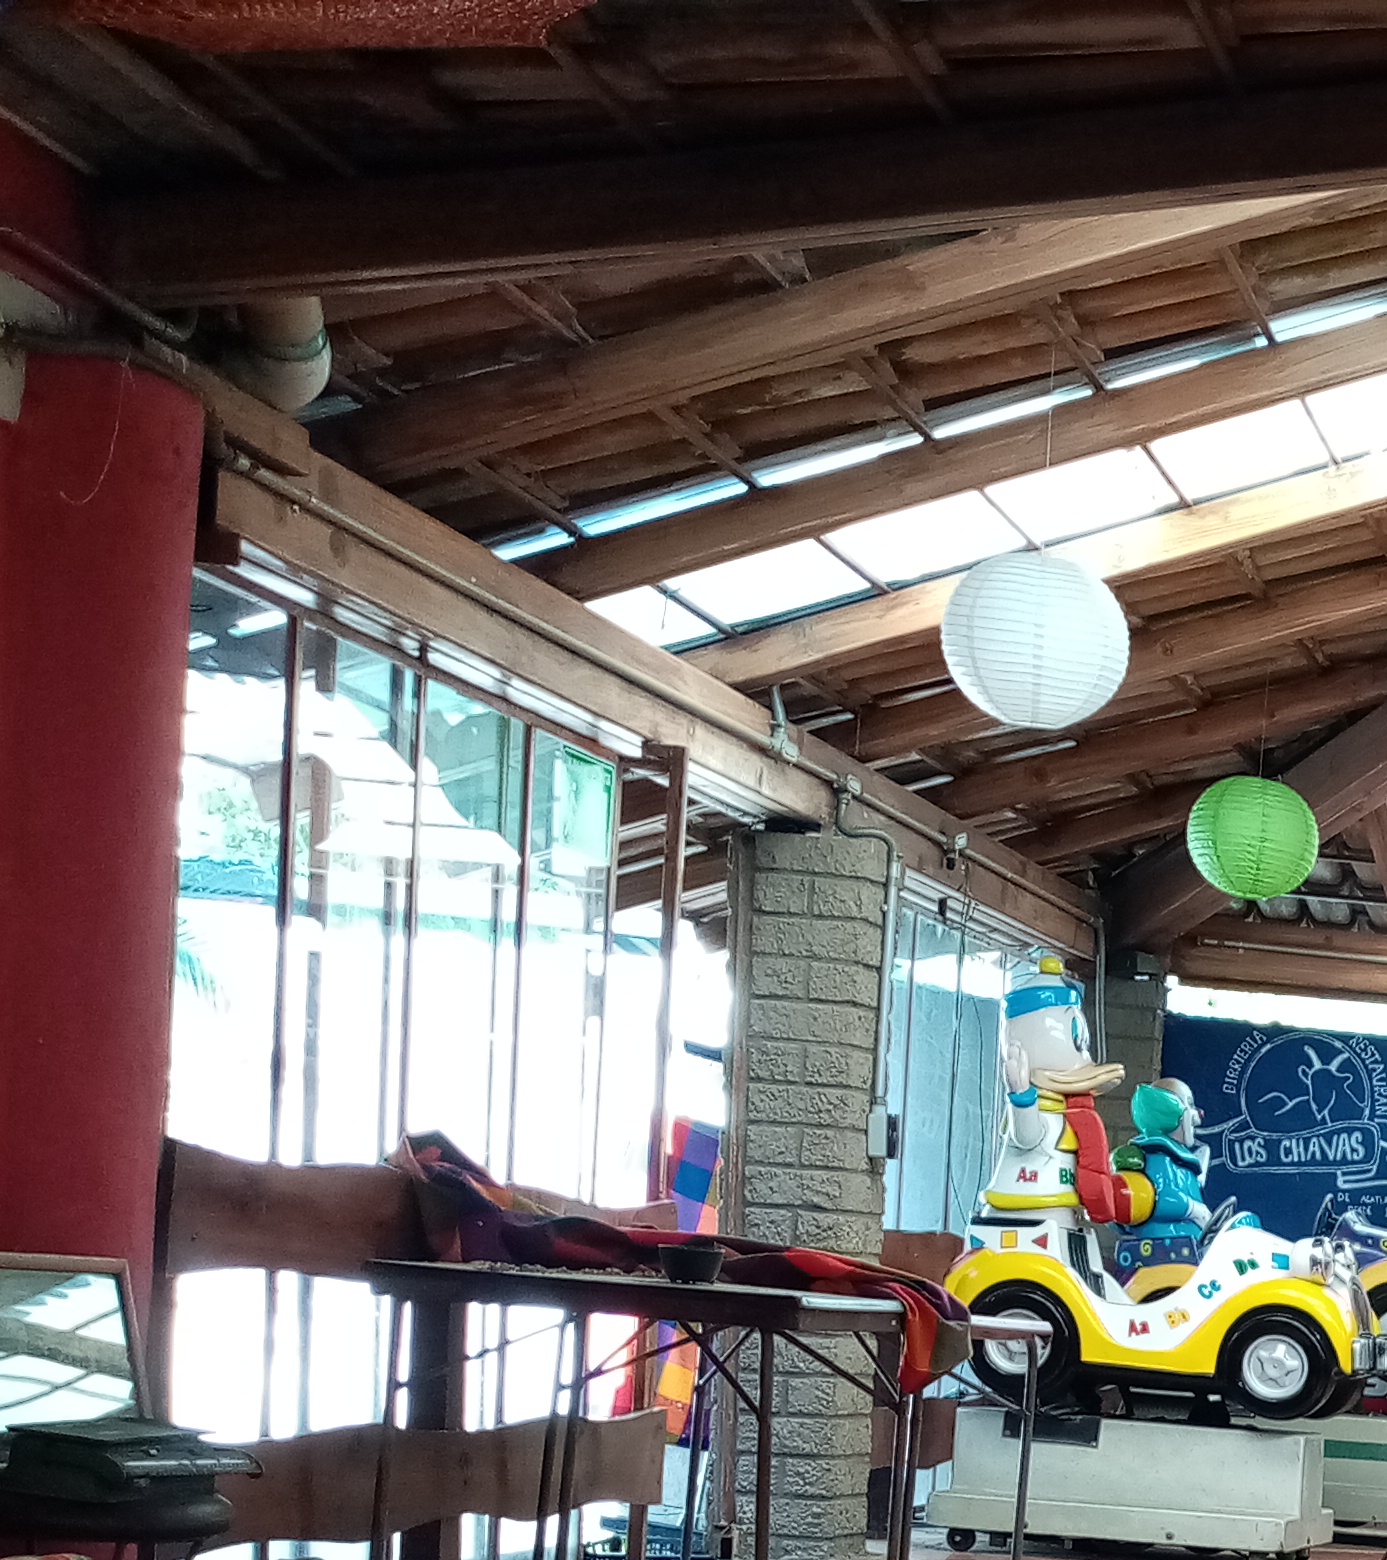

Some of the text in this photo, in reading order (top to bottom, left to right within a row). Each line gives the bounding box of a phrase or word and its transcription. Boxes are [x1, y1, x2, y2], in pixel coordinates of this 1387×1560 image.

[1235, 1131, 1364, 1166] LOS CHAVAS
[1015, 1166, 1038, 1183] Aa
[1128, 1319, 1150, 1337] Aa
